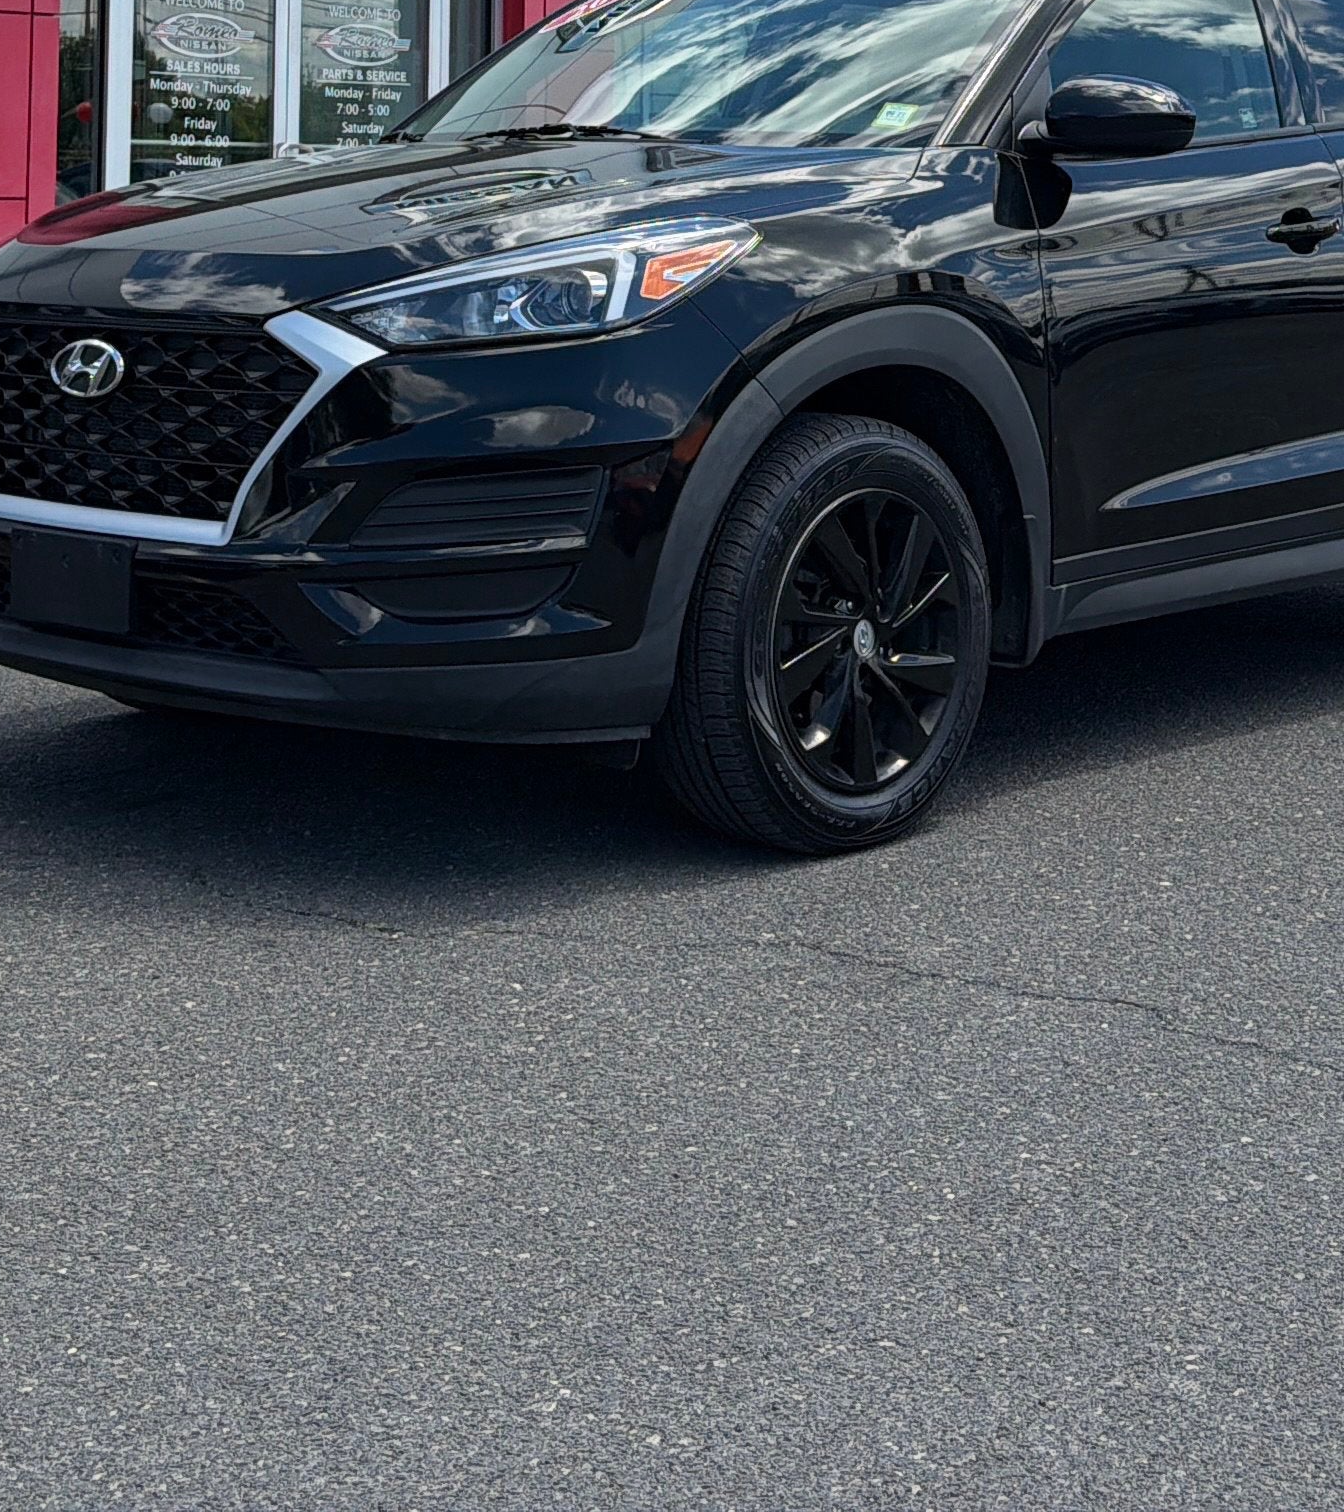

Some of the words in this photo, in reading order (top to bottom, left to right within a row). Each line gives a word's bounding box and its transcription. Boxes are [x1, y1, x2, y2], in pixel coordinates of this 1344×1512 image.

[328, 5, 385, 20] WELCOME
[386, 8, 402, 22] TO
[175, 16, 240, 39] Romeo
[179, 39, 227, 50] NISSAN
[343, 49, 386, 59] NISSAN
[166, 59, 201, 73] SALES
[203, 62, 241, 75] HOURS
[322, 68, 354, 80] PARTS
[356, 69, 364, 81] &
[366, 70, 407, 82] SERVICE
[150, 78, 194, 95] Monday
[202, 80, 252, 97] Thursday
[324, 85, 364, 101] Monday
[371, 87, 402, 103] Friday
[171, 96, 196, 110] 9:00
[206, 97, 231, 112] 7:00
[336, 102, 359, 115] 7:00
[367, 103, 390, 116] 5:00
[184, 116, 218, 133] Friday
[341, 120, 385, 137] Saturday
[170, 133, 196, 147] 9:00
[204, 134, 230, 148] 6:00
[336, 138, 359, 148] 7:00
[175, 152, 223, 168] Saturday
